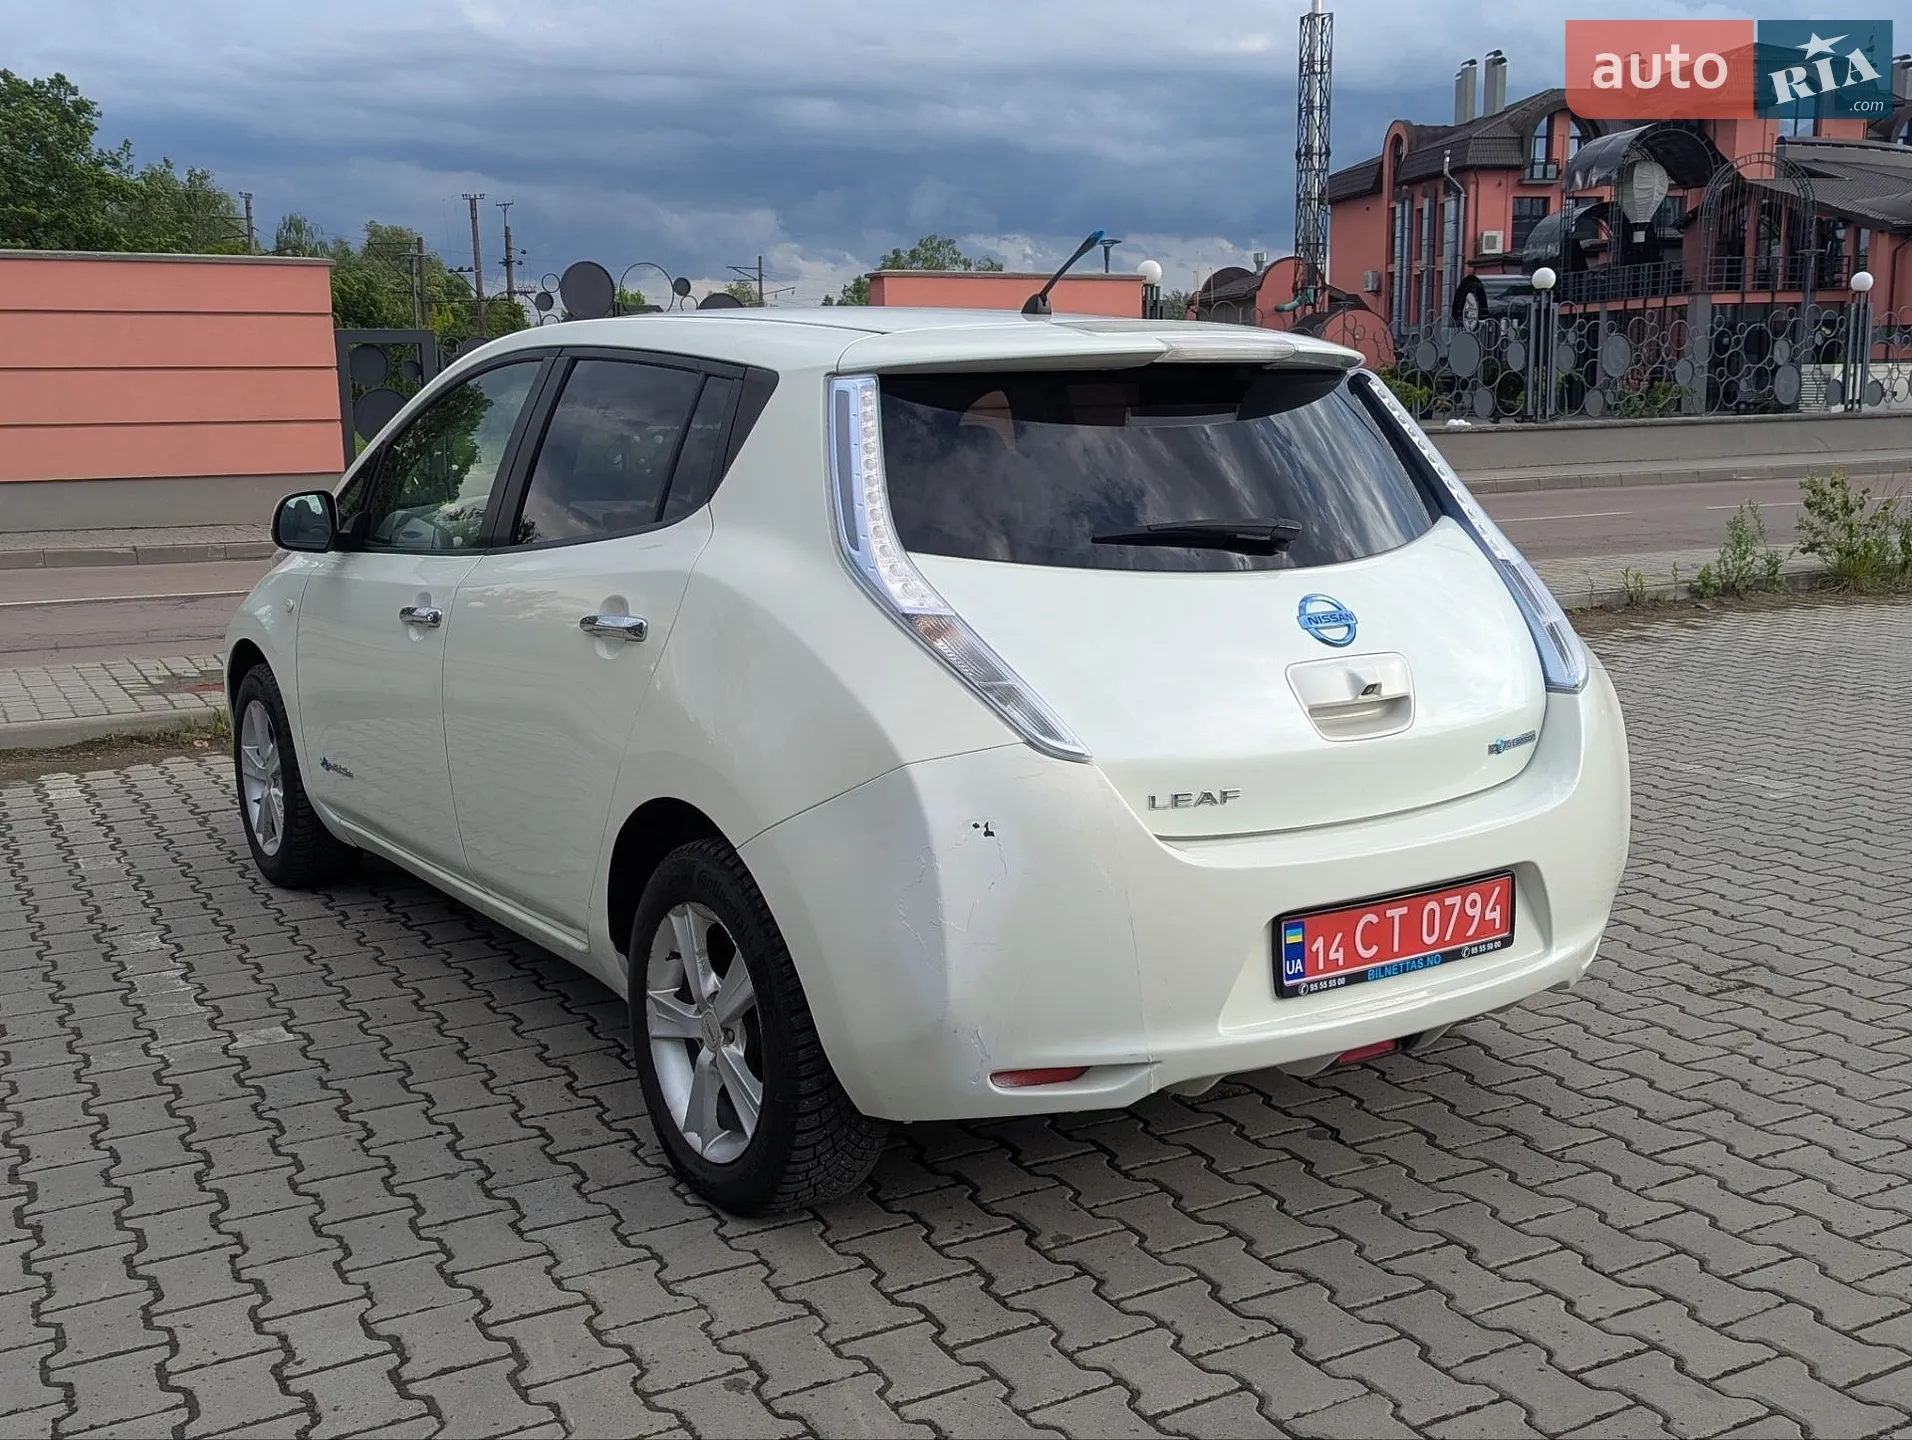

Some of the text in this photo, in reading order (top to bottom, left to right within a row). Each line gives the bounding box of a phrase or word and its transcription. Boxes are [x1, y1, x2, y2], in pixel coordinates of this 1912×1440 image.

[1306, 612, 1354, 626] NISSAN
[1148, 788, 1242, 811] LEAF
[1421, 886, 1501, 945] 0794
[1286, 958, 1304, 975] UA
[1367, 954, 1442, 981] BILNETTAS.NO
